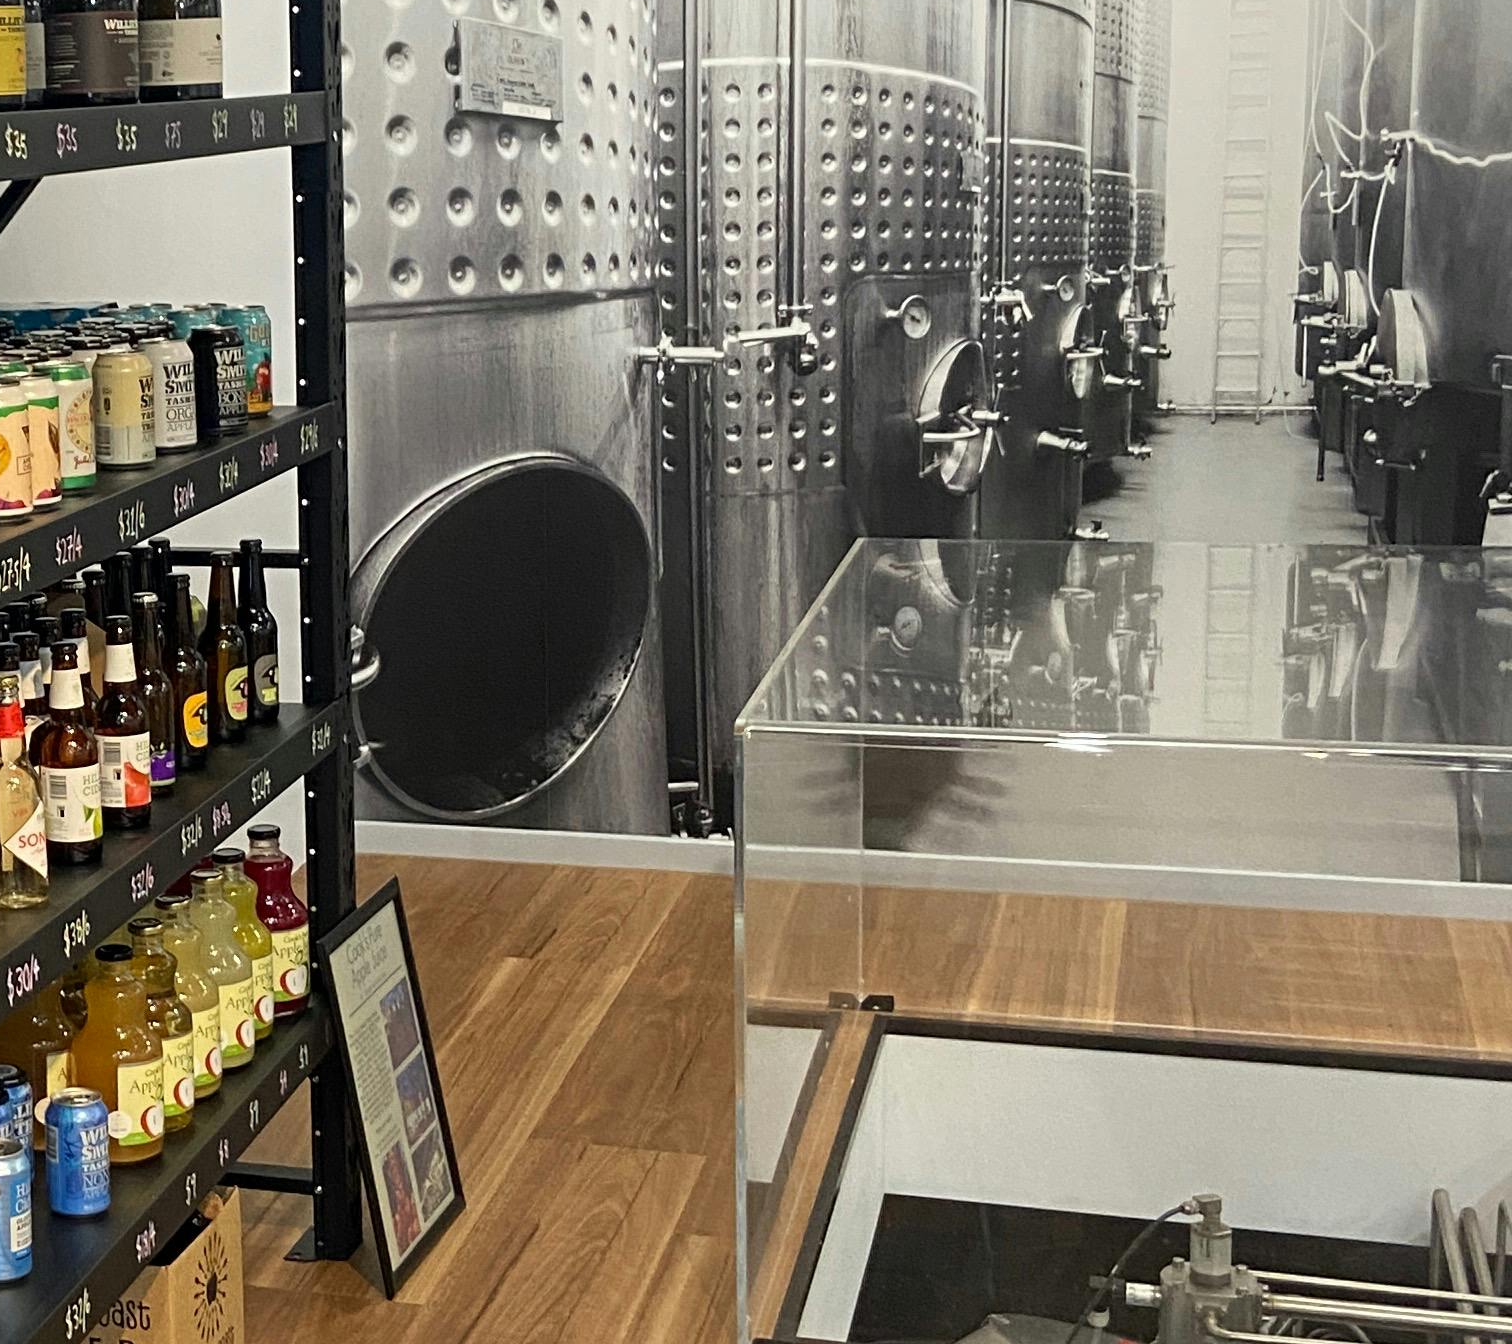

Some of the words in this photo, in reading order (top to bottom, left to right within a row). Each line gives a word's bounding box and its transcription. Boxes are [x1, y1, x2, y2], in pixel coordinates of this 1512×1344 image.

[5, 122, 28, 161] $35
[55, 122, 79, 159] $35
[114, 117, 139, 153] $35
[118, 499, 146, 543] $31/6
[55, 525, 82, 566] $27/4
[6, 953, 40, 1006] $30/4
